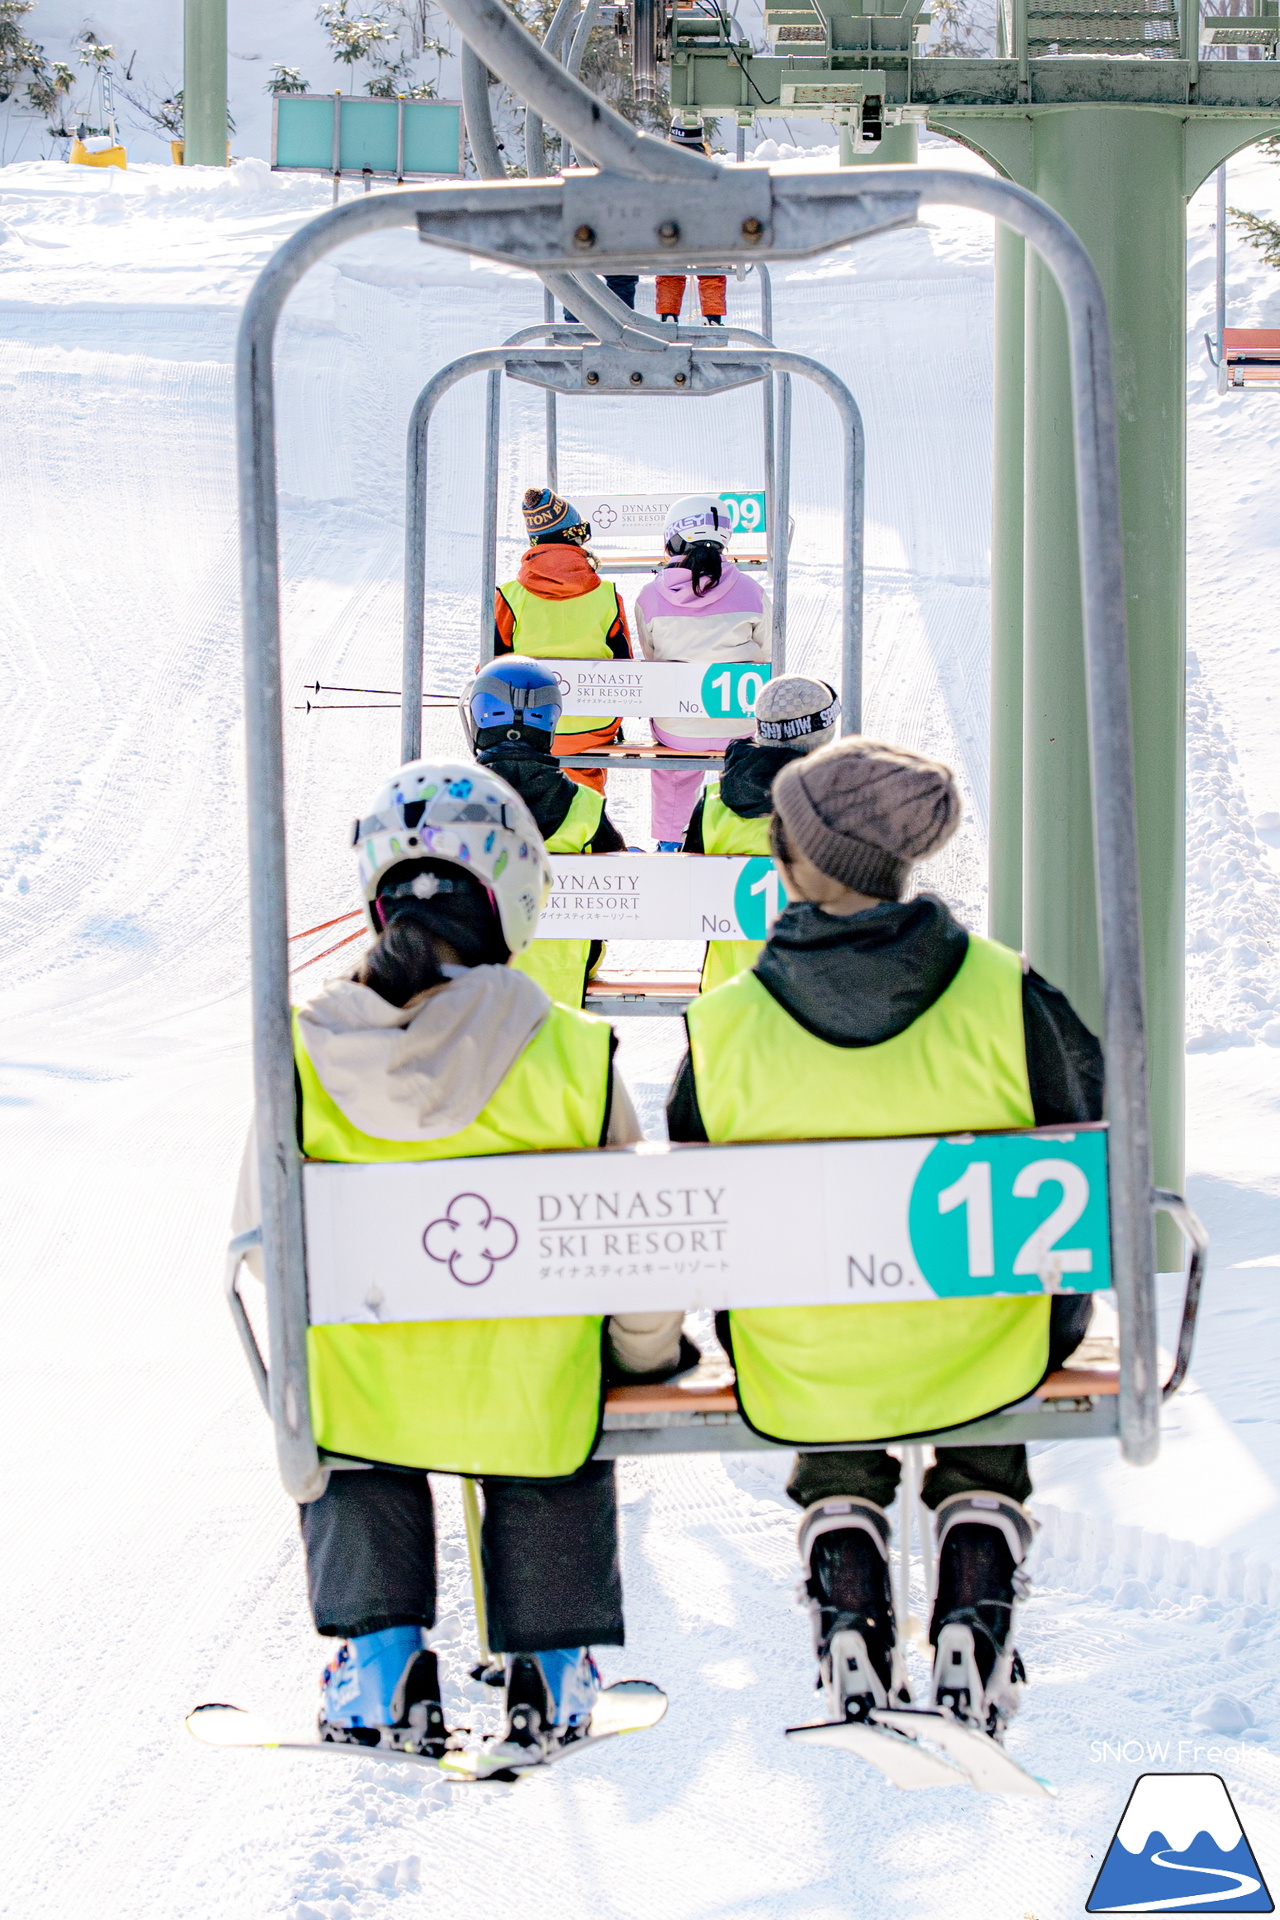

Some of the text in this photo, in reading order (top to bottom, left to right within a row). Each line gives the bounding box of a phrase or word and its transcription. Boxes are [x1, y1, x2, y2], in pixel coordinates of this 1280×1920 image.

[622, 504, 671, 513] DYNASTY
[638, 514, 666, 522] RESOR
[577, 673, 643, 685] DYNASTY
[577, 688, 643, 698] SKI RESORT
[679, 671, 764, 713] No. 10
[551, 875, 640, 890] YNASTY
[574, 897, 640, 909] RESORT
[702, 869, 779, 933] No. 1
[537, 1187, 726, 1222] DYNASTY
[846, 1158, 1093, 1288] No. 12
[539, 1229, 728, 1258] SKI RESORT
